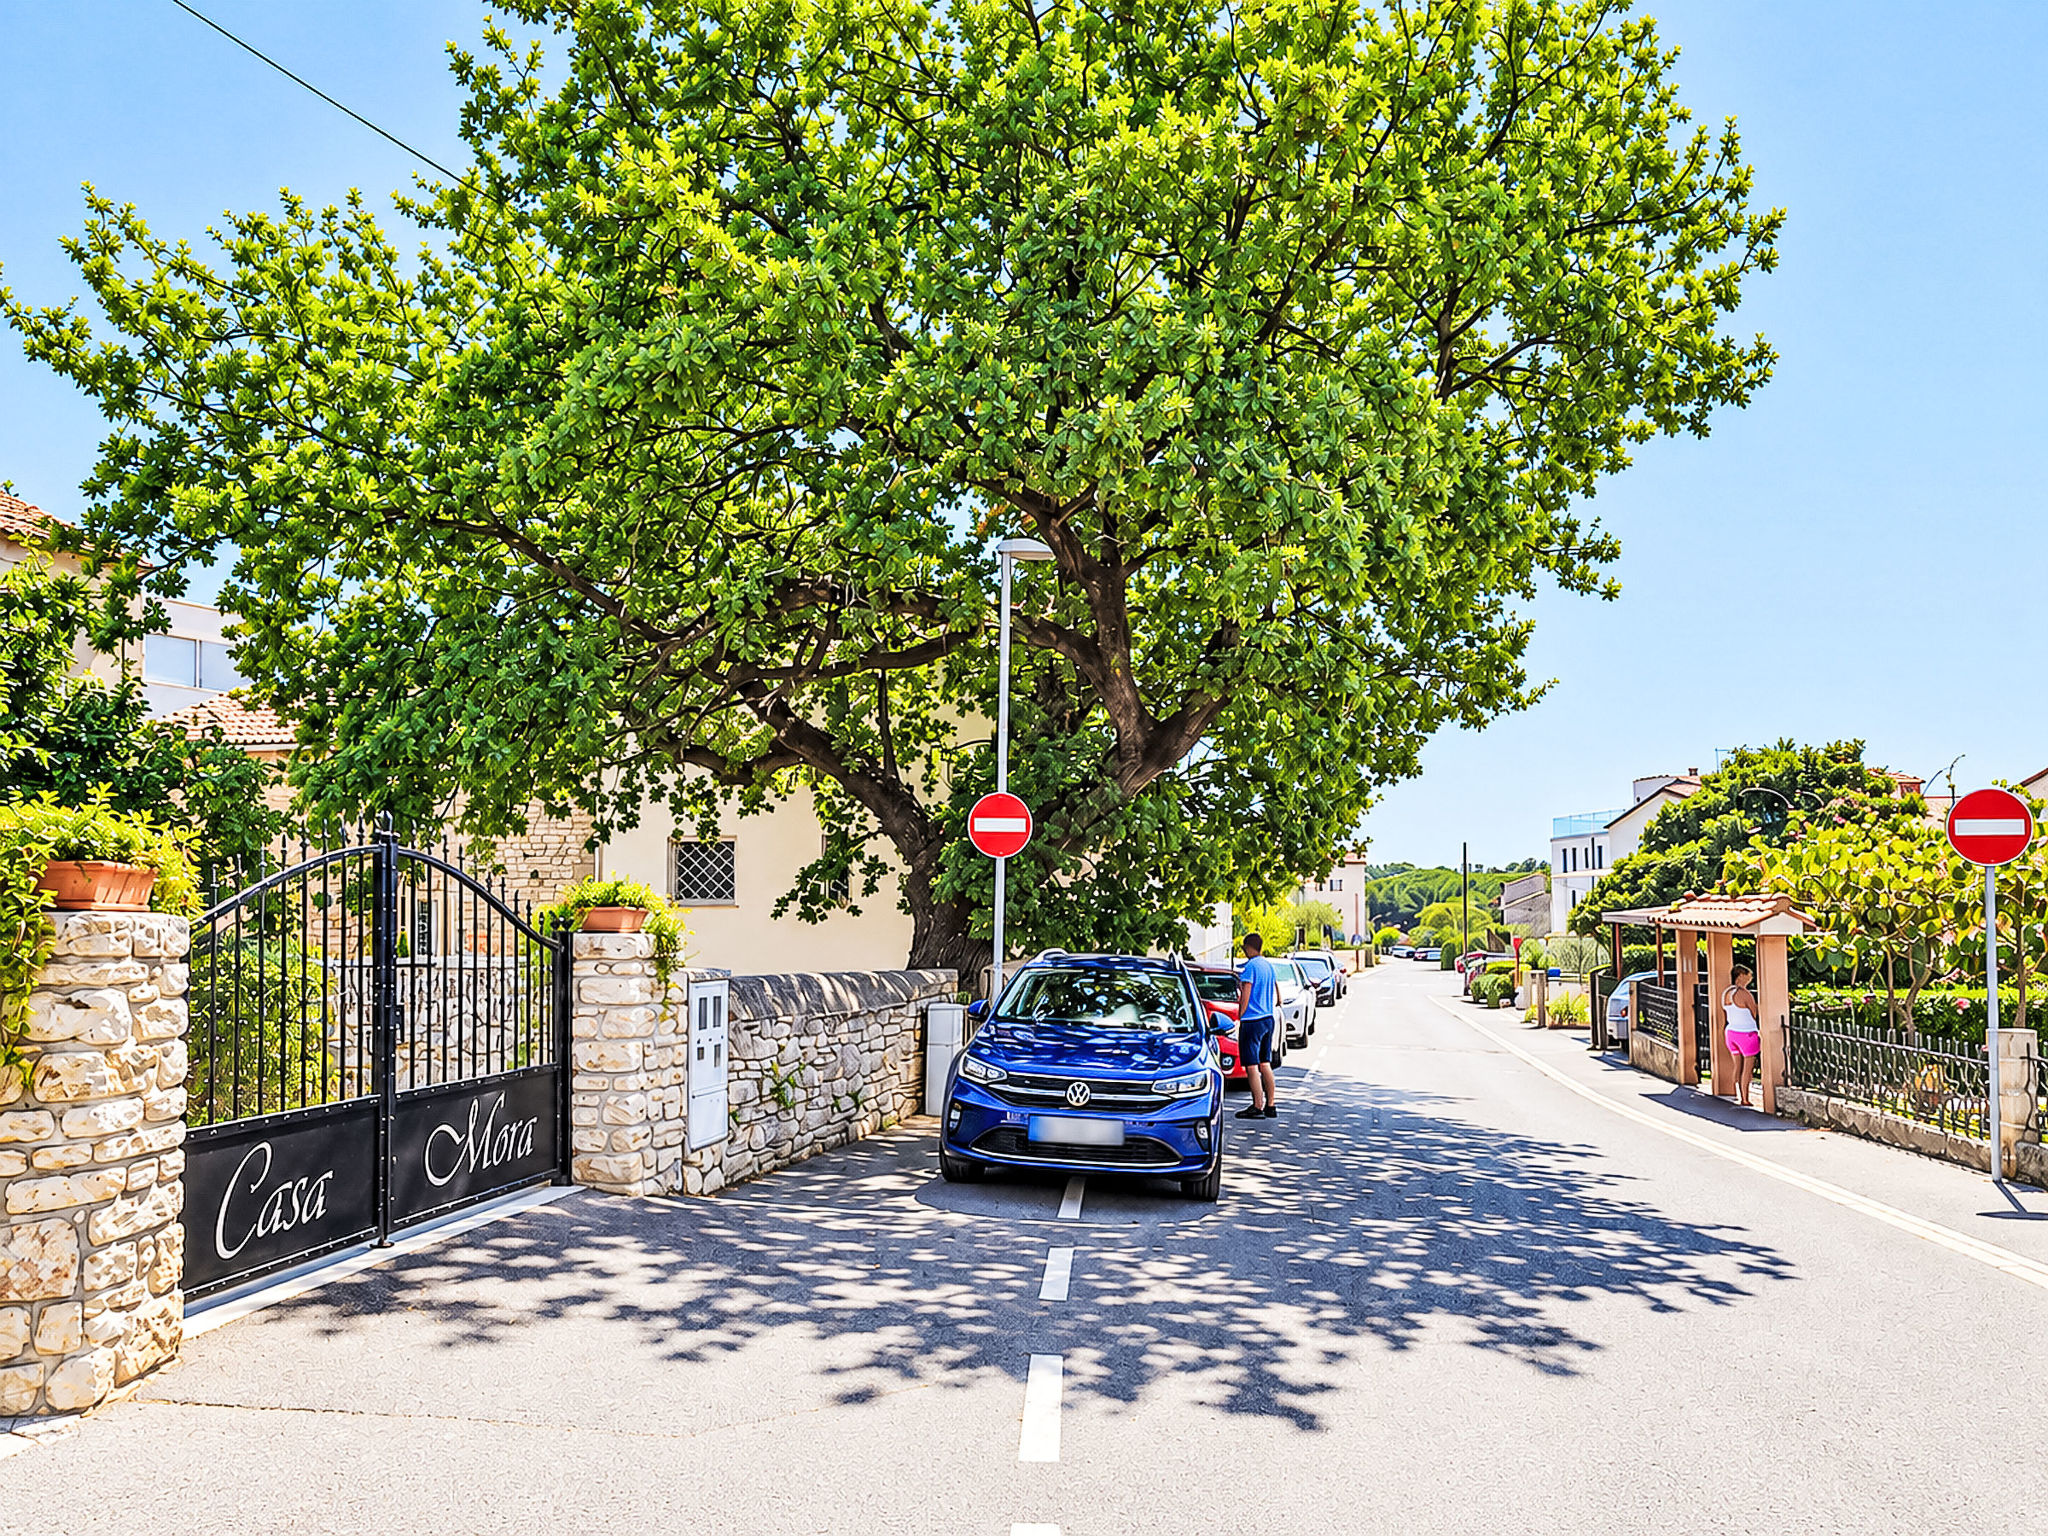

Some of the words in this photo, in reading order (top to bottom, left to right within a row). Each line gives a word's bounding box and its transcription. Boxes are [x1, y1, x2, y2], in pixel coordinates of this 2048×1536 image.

[1067, 1082, 1090, 1106] VW
[215, 1141, 334, 1259] Casa
[425, 1091, 538, 1186] Mora
